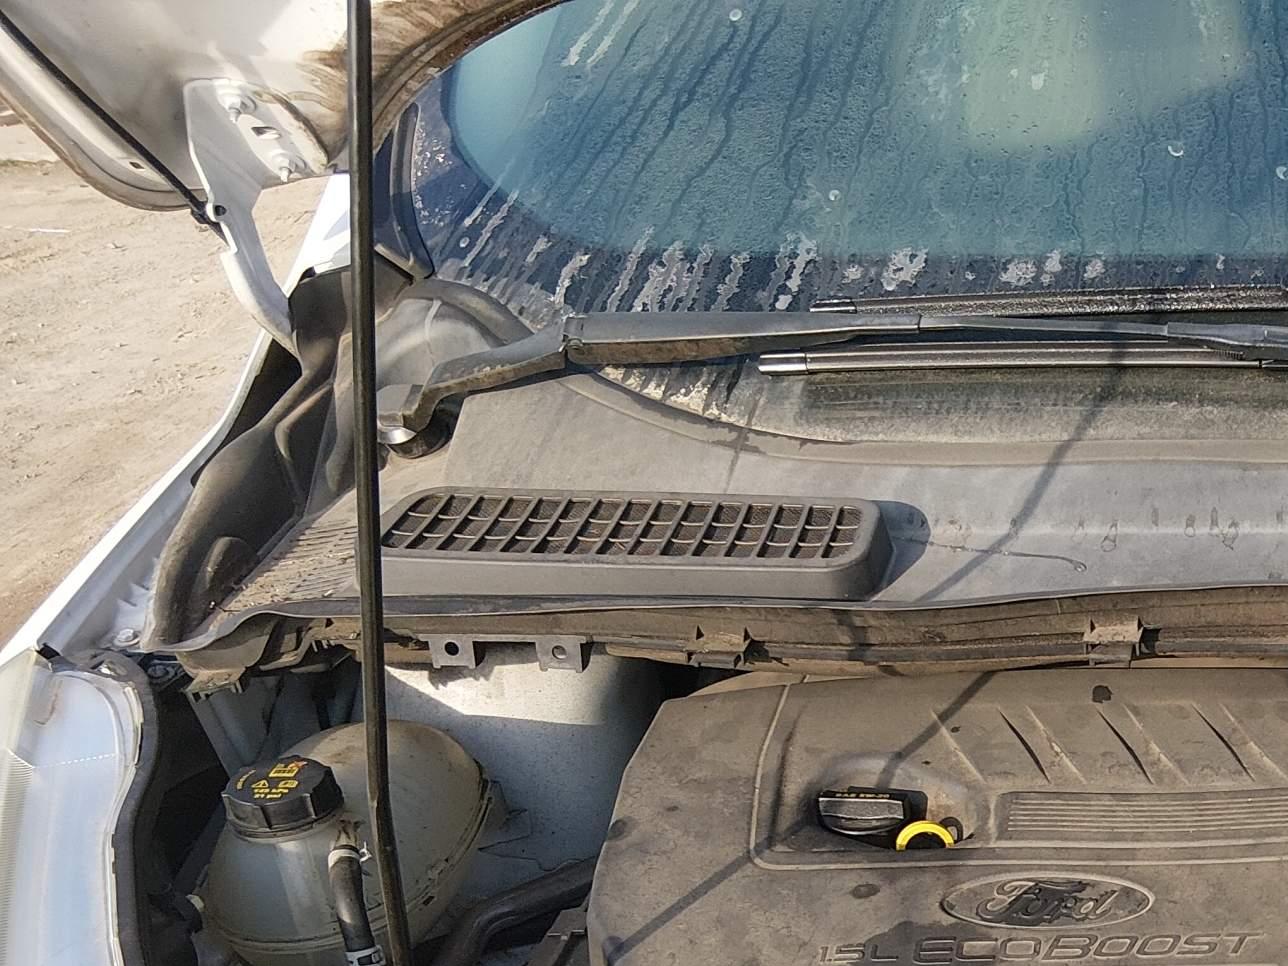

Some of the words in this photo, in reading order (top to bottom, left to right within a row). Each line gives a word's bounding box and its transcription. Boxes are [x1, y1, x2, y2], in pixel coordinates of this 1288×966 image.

[976, 879, 1119, 926] Ford
[819, 942, 899, 963] 1.5L
[911, 930, 1266, 966] ECOBOOST
